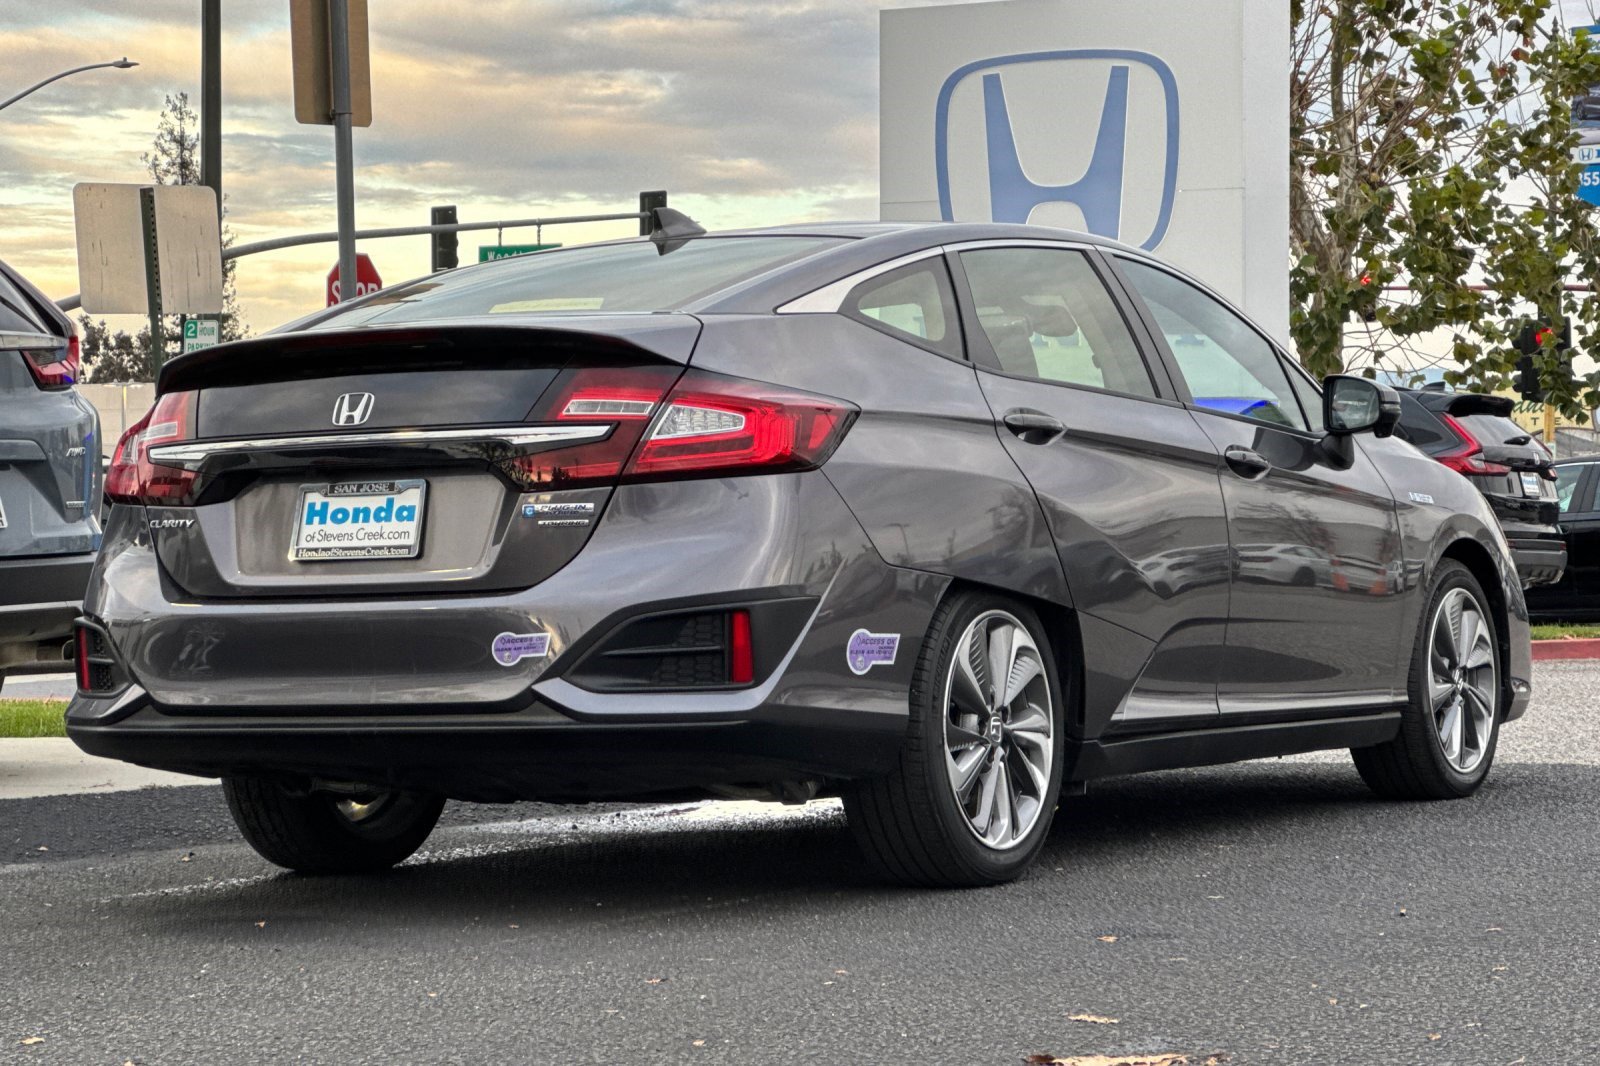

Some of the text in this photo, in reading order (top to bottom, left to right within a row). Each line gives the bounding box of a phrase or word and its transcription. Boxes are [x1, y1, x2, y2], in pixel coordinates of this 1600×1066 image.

[331, 280, 379, 306] SOP
[187, 323, 216, 337] 2 HOUR
[334, 481, 391, 494] SAN JOSE
[305, 497, 417, 525] Honda
[540, 503, 588, 511] PLUG-IN
[149, 519, 195, 528] CLARITY
[317, 529, 354, 542] Stevens
[355, 526, 410, 541] Creek.com
